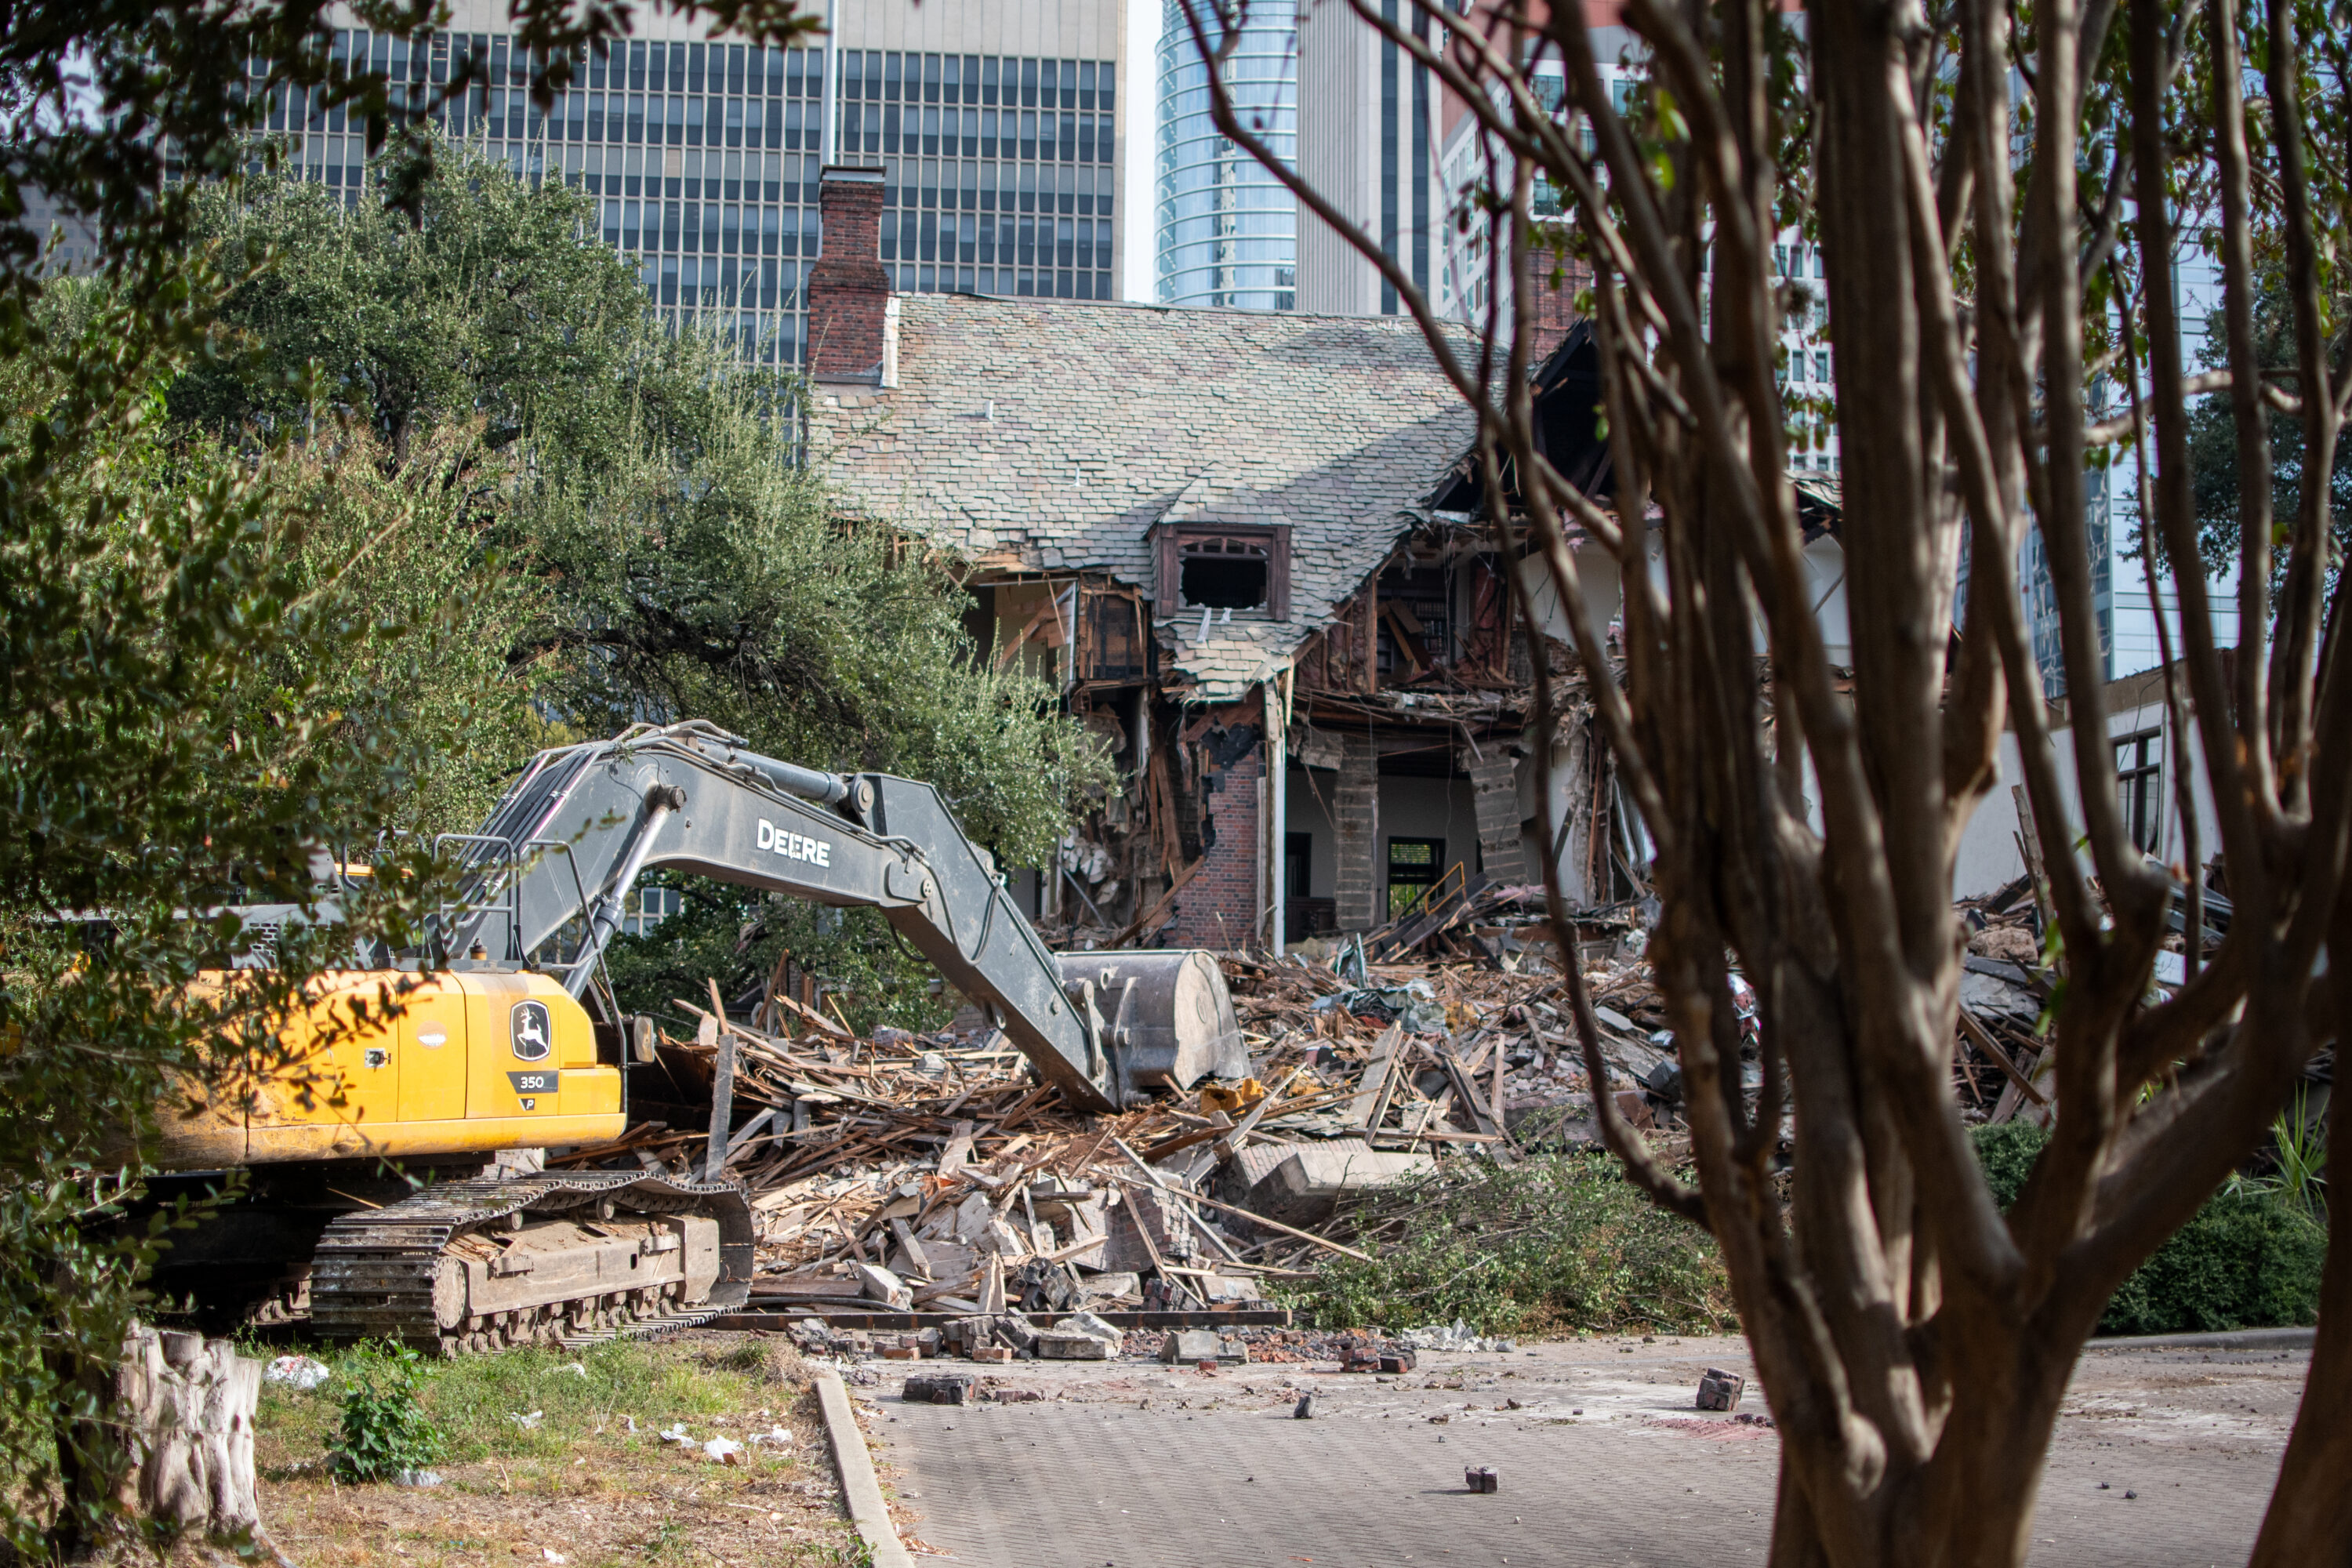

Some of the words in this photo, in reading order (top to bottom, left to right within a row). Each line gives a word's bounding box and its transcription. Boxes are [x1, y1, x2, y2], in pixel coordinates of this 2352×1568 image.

[757, 818, 830, 867] DEERE
[520, 1076, 544, 1089] 350
[526, 1099, 535, 1109] P
